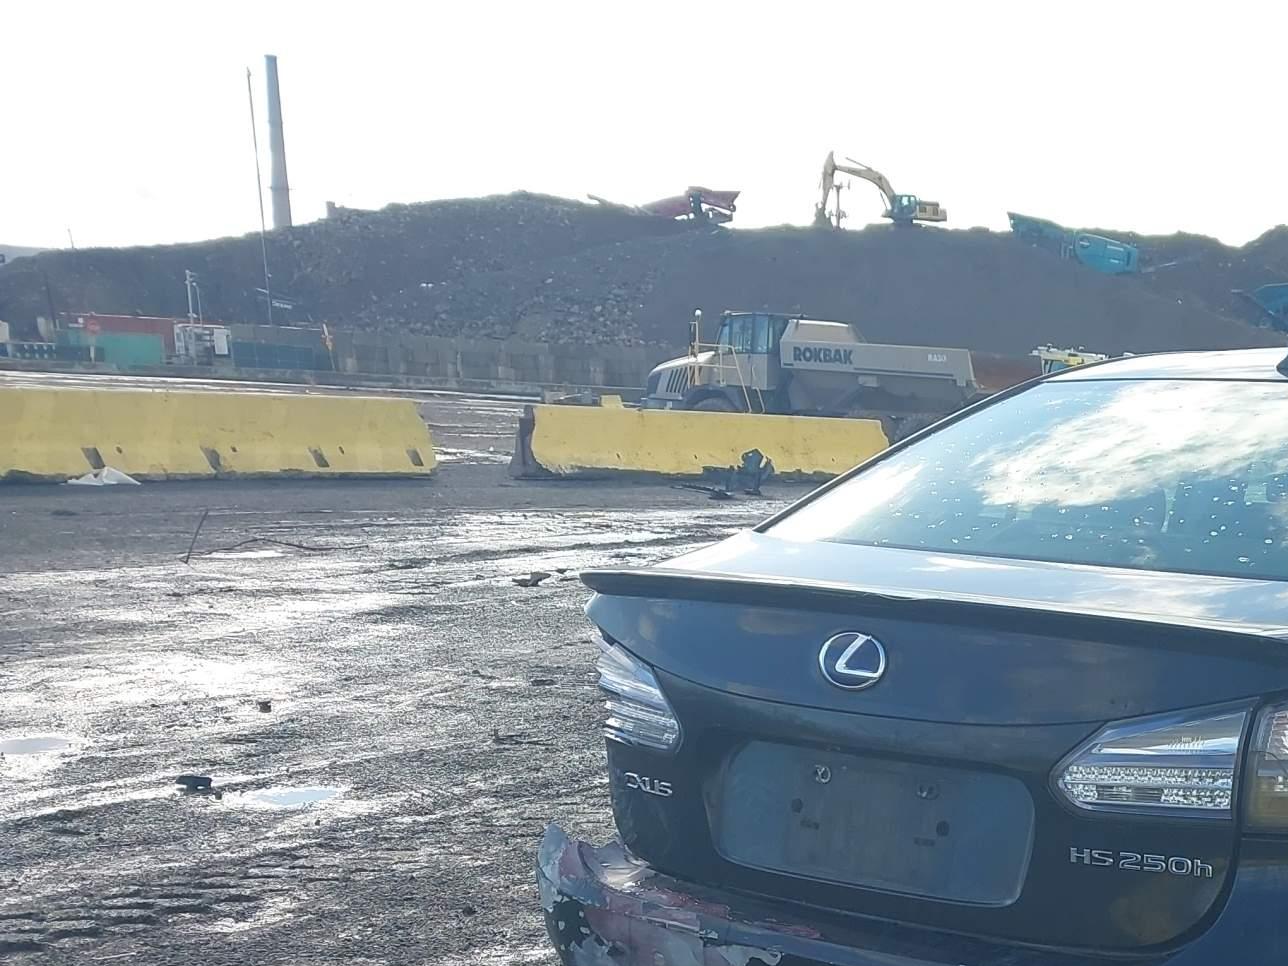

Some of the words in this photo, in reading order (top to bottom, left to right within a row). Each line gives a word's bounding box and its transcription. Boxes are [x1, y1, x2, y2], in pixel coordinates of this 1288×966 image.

[793, 346, 853, 365] ROKBAK
[1069, 847, 1114, 866] HS
[1118, 851, 1213, 878] 250h
